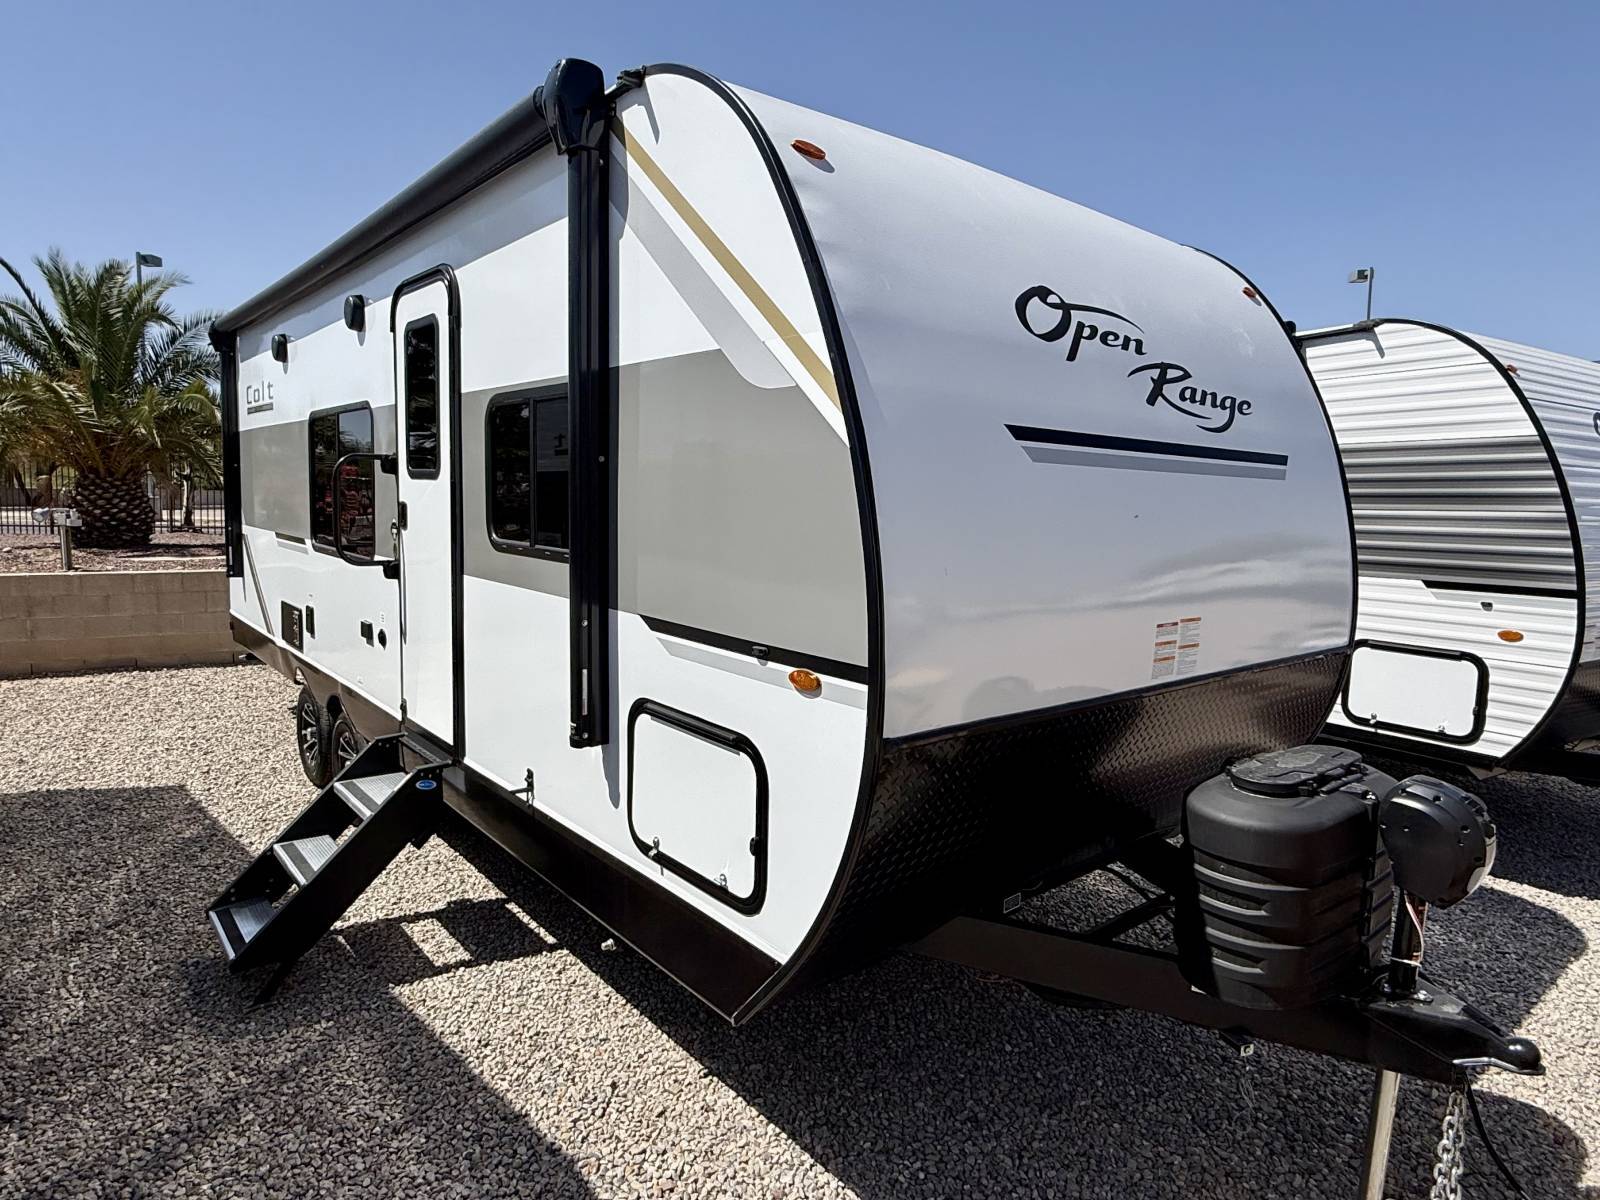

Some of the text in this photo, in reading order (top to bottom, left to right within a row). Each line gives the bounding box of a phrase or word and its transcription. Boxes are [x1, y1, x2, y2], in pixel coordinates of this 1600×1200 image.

[1015, 285, 1147, 362] Open
[246, 380, 274, 404] Colt
[1127, 361, 1253, 433] Range
